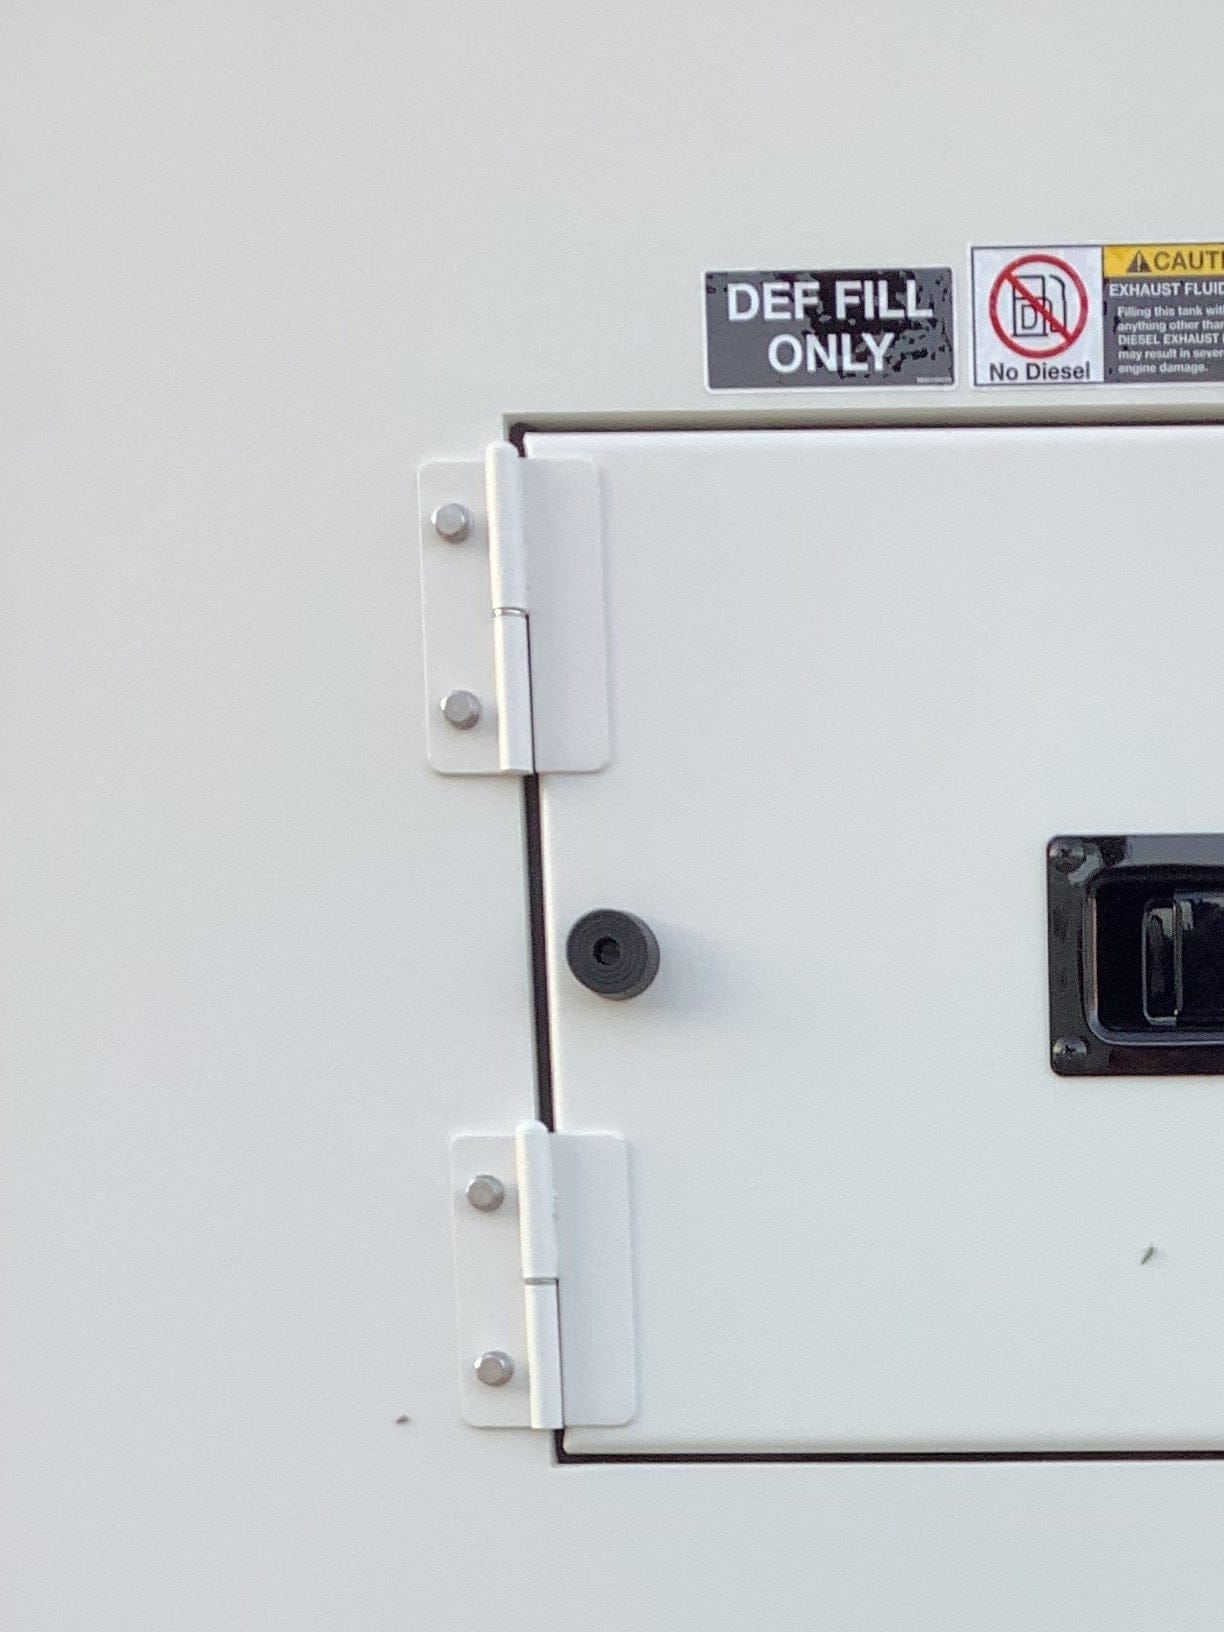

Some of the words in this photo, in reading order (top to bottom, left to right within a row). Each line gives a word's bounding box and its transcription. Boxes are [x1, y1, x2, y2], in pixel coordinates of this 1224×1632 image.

[1109, 282, 1182, 297] EXHAUST
[728, 280, 821, 323] DEF
[834, 279, 933, 321] FILL
[1117, 306, 1152, 319] Filling
[1154, 305, 1176, 317] this
[1178, 305, 1204, 316] tank
[1118, 320, 1166, 333] anything
[1169, 319, 1200, 330] other
[1117, 334, 1160, 346] DIESEL
[1163, 333, 1219, 345] EXHAUST
[767, 333, 897, 374] ONLY
[1118, 349, 1142, 361] may
[1145, 348, 1177, 360] result
[1180, 347, 1191, 359] in
[989, 362, 1019, 381] No
[1025, 360, 1091, 380] Diesel
[1118, 362, 1156, 376] engine
[1159, 361, 1209, 375] damage.
